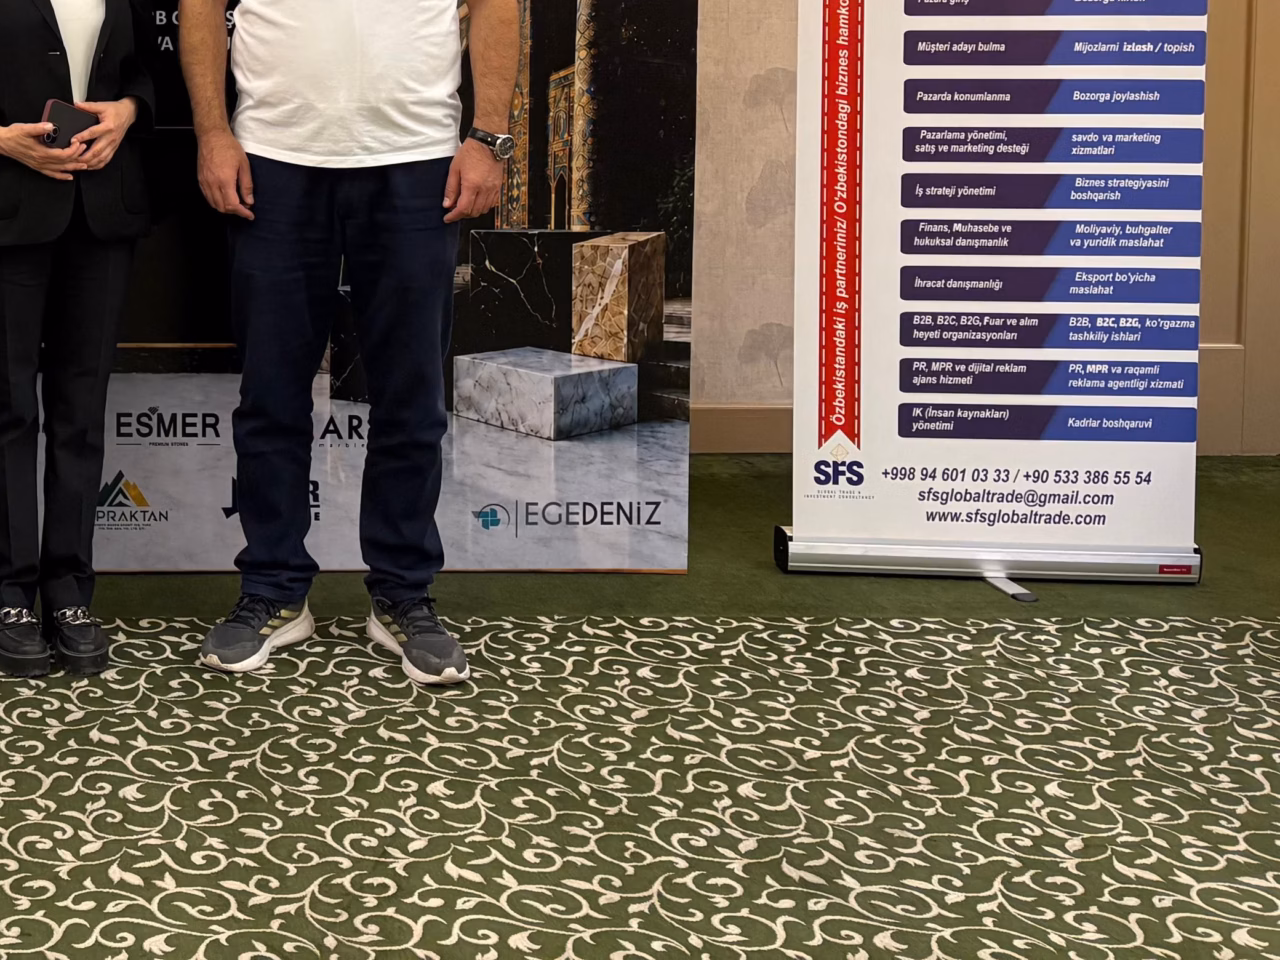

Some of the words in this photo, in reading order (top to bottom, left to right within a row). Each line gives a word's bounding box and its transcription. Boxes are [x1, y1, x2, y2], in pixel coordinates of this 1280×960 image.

[918, 42, 950, 53] Müşteri
[952, 42, 976, 53] adayı
[978, 42, 1005, 51] bulma
[1074, 42, 1119, 53] Mijozlarni
[1123, 42, 1153, 51] izlash
[1164, 43, 1194, 54] topish
[836, 50, 848, 95] biznes
[917, 92, 951, 100] Pazarda
[954, 92, 1010, 101] konumlanma
[1073, 91, 1110, 102] Bozorga
[1111, 91, 1160, 102] joylashish
[920, 130, 965, 139] Pazarlama
[967, 130, 1007, 141] yönetimi,
[1072, 133, 1098, 141] savdo
[1115, 133, 1161, 144] marketing
[915, 144, 935, 154] satış
[951, 143, 994, 154] marketing
[997, 143, 1029, 155] desteği
[1072, 146, 1115, 154] xizmatlari
[834, 99, 850, 212] O'zbekistondagi
[1075, 178, 1105, 187] Biznes
[1108, 178, 1169, 189] strategiyasini
[916, 184, 923, 197] İş
[926, 186, 956, 197] strateji
[958, 186, 996, 197] yönetimi
[1071, 191, 1120, 202] boshqarish
[919, 223, 950, 233] Finans,
[953, 223, 999, 232] Muhasebe
[1076, 224, 1122, 236] Moliyaviy,
[1126, 225, 1173, 236] buhgalter
[914, 237, 953, 246] hukuksal
[956, 237, 1009, 248] danışmanlık
[1083, 237, 1116, 248] yuridik
[1119, 238, 1164, 247] maslahat
[915, 277, 945, 287] İhracat
[947, 279, 1002, 290] danışmanlığı
[1075, 272, 1113, 283] Eksport
[1115, 272, 1155, 284] bo'yicha
[1070, 285, 1113, 294] maslahat
[834, 302, 848, 313] iş
[913, 315, 934, 325] B2B,
[937, 316, 958, 326] B2C,
[960, 316, 982, 326] B2G,
[984, 316, 1005, 325] Fuar
[1019, 317, 1038, 326] alım
[1069, 317, 1091, 328] B2B,
[1097, 318, 1117, 327] B2C,
[1119, 318, 1141, 328] B2G,
[1145, 318, 1195, 329] ko'rgazma
[913, 329, 940, 340] heyeti
[943, 330, 1017, 341] organizasyonları
[1069, 331, 1109, 343] tashkiliy
[1111, 332, 1141, 341] ishlari
[830, 317, 845, 425] Özbekistandaki
[913, 362, 928, 372] PR,
[931, 362, 953, 371] MPR
[968, 363, 994, 374] dijital
[996, 363, 1026, 372] reklam
[1069, 364, 1084, 374] PR,
[1086, 365, 1108, 373] MPR
[1124, 365, 1159, 376] raqamli
[913, 375, 937, 385] ajans
[940, 375, 973, 384] hizmeti
[1069, 378, 1105, 387] reklama
[1108, 379, 1148, 390] agentligi
[1150, 379, 1184, 388] xizmati
[913, 408, 923, 416] IK
[925, 406, 954, 419] (İnsan
[957, 409, 1009, 420] kaynakları)
[116, 412, 221, 438] ESMER
[912, 421, 953, 431] yönetimi
[1068, 418, 1100, 427] Kadrlar
[1103, 418, 1152, 429] boshqaruvi
[814, 460, 865, 487] SFS
[882, 467, 915, 480] +998
[921, 468, 936, 481] 94
[942, 468, 966, 481] 601
[972, 469, 988, 482] 03
[993, 469, 1009, 482] 33
[1024, 470, 1049, 483] +90
[1054, 470, 1078, 484] 533
[1084, 471, 1109, 484] 386
[1114, 471, 1130, 484] 55
[1135, 472, 1151, 485] 54
[918, 488, 1114, 507] sfsglobaltrade@gmail.com
[926, 509, 1106, 526] www.sfsglobaltrade.com
